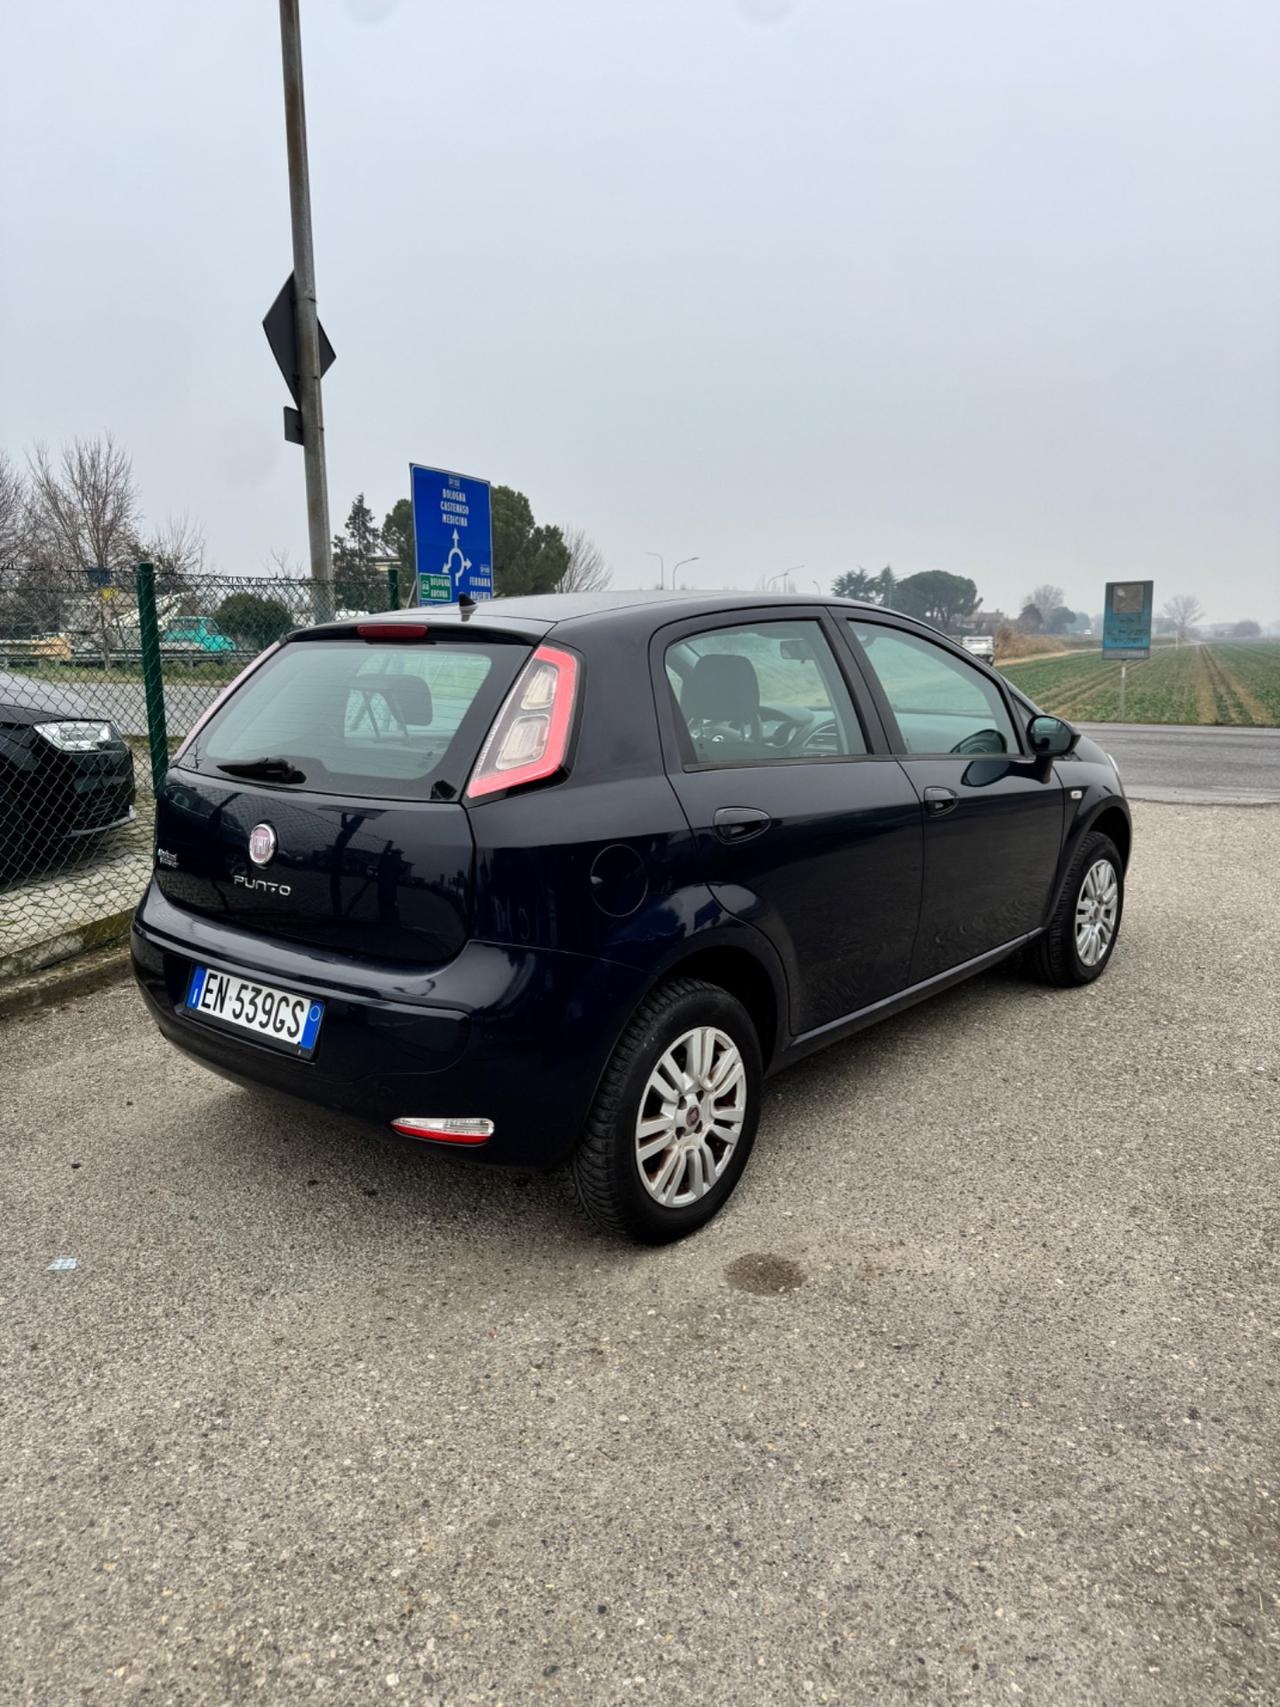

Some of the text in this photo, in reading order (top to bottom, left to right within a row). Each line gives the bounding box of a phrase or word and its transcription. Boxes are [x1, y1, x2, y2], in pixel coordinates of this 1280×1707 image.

[442, 488, 466, 502] BOLOGNA
[440, 501, 469, 515] CASTENASO
[442, 513, 468, 527] MEDICINA
[233, 875, 291, 896] PUNTO
[201, 973, 305, 1038] EN 539GS
